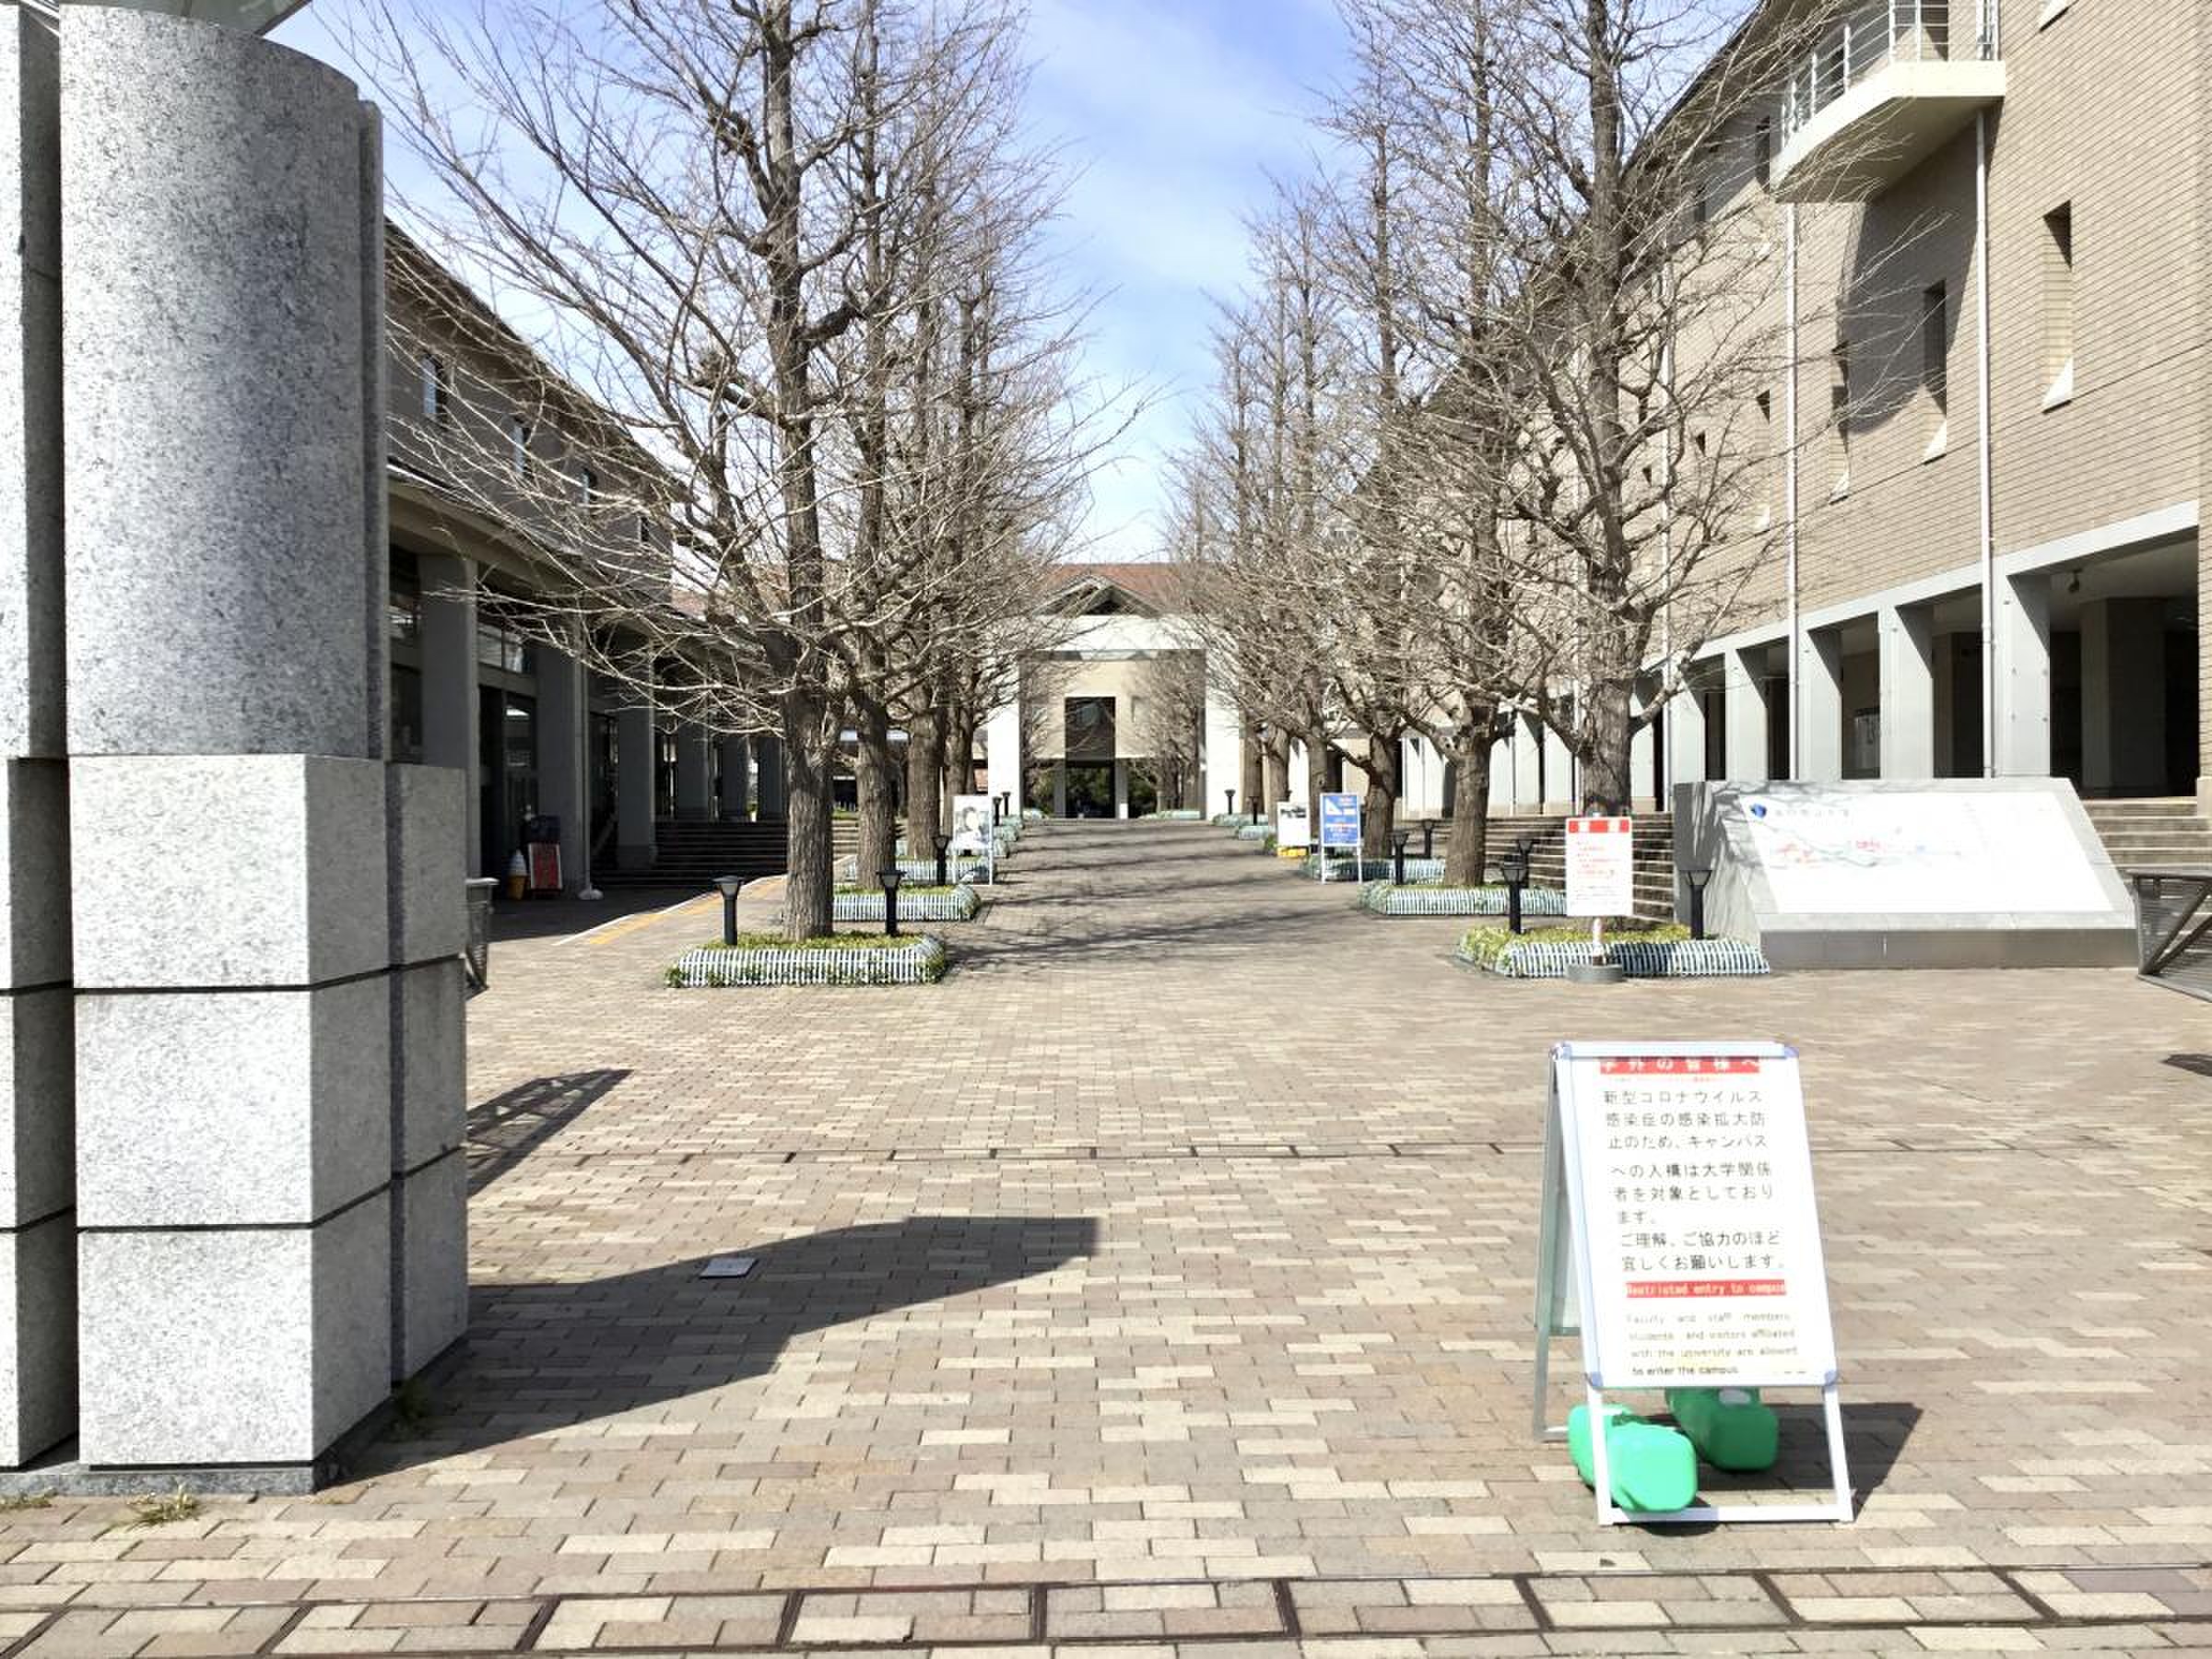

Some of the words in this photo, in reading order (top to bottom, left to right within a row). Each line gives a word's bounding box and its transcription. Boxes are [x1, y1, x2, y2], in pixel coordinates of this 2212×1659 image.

[1604, 1090, 1762, 1105] 新型コロナウイルス
[1606, 1112, 1765, 1127] 感染症の感染拡大防
[1614, 1184, 1772, 1202] 者を対象としており
[1618, 1209, 1656, 1224] ます。
[1621, 1230, 1781, 1247] ご理解、ご協力のほど
[1686, 1330, 1704, 1340] and
[1658, 1347, 1675, 1358] the
[1647, 1365, 1675, 1376] enter
[1678, 1365, 1695, 1375] the
